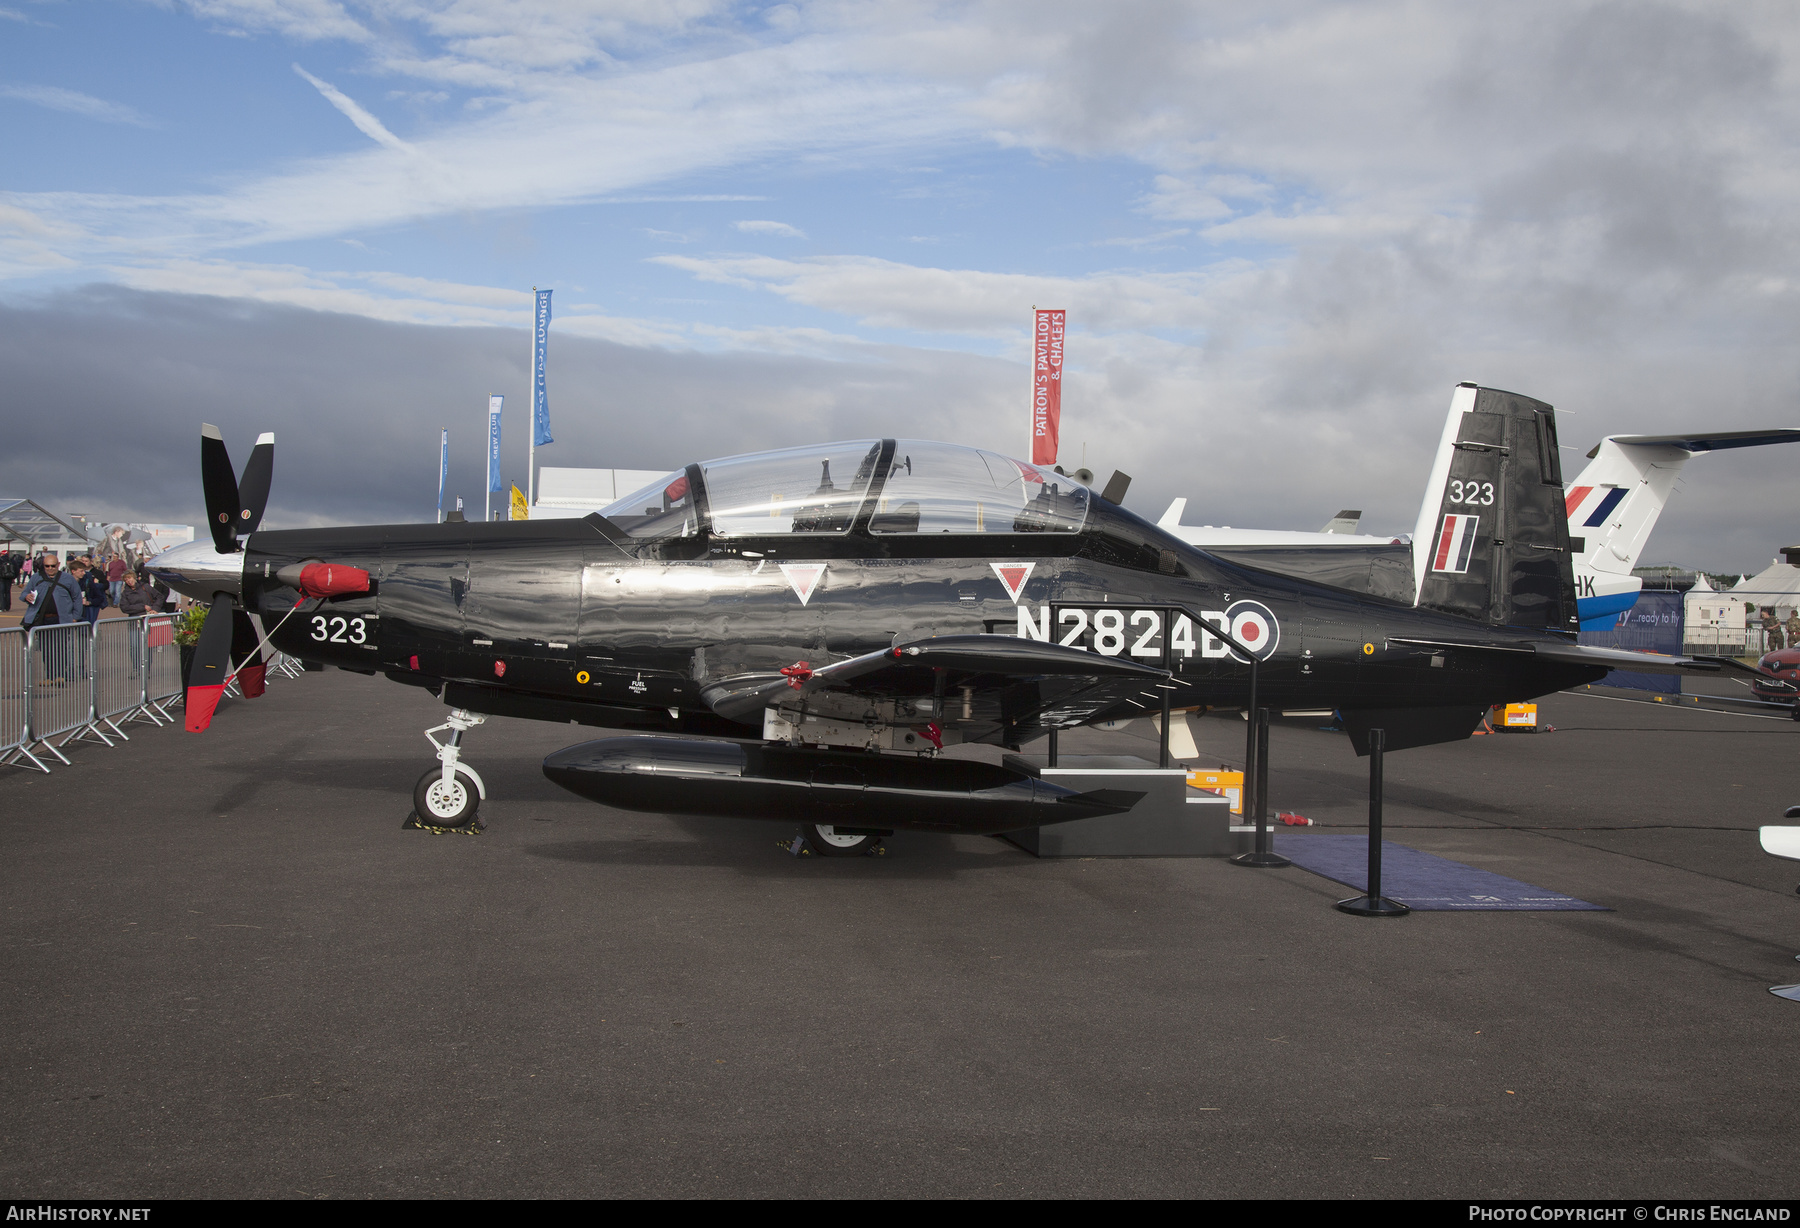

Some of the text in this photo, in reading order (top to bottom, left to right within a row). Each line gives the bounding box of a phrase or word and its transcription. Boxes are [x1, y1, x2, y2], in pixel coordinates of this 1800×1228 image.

[538, 292, 549, 344] LOUNGE
[1050, 313, 1064, 380] & CHALETS
[1035, 313, 1049, 437] PATRON'S PAVILION
[1449, 480, 1494, 506] 323
[997, 573, 1012, 591] DANGER
[1017, 573, 1029, 591] DANGER
[310, 615, 367, 645] 323
[1017, 605, 1231, 659] N2824B
[1661, 612, 1670, 624] to
[1671, 611, 1680, 627] fly
